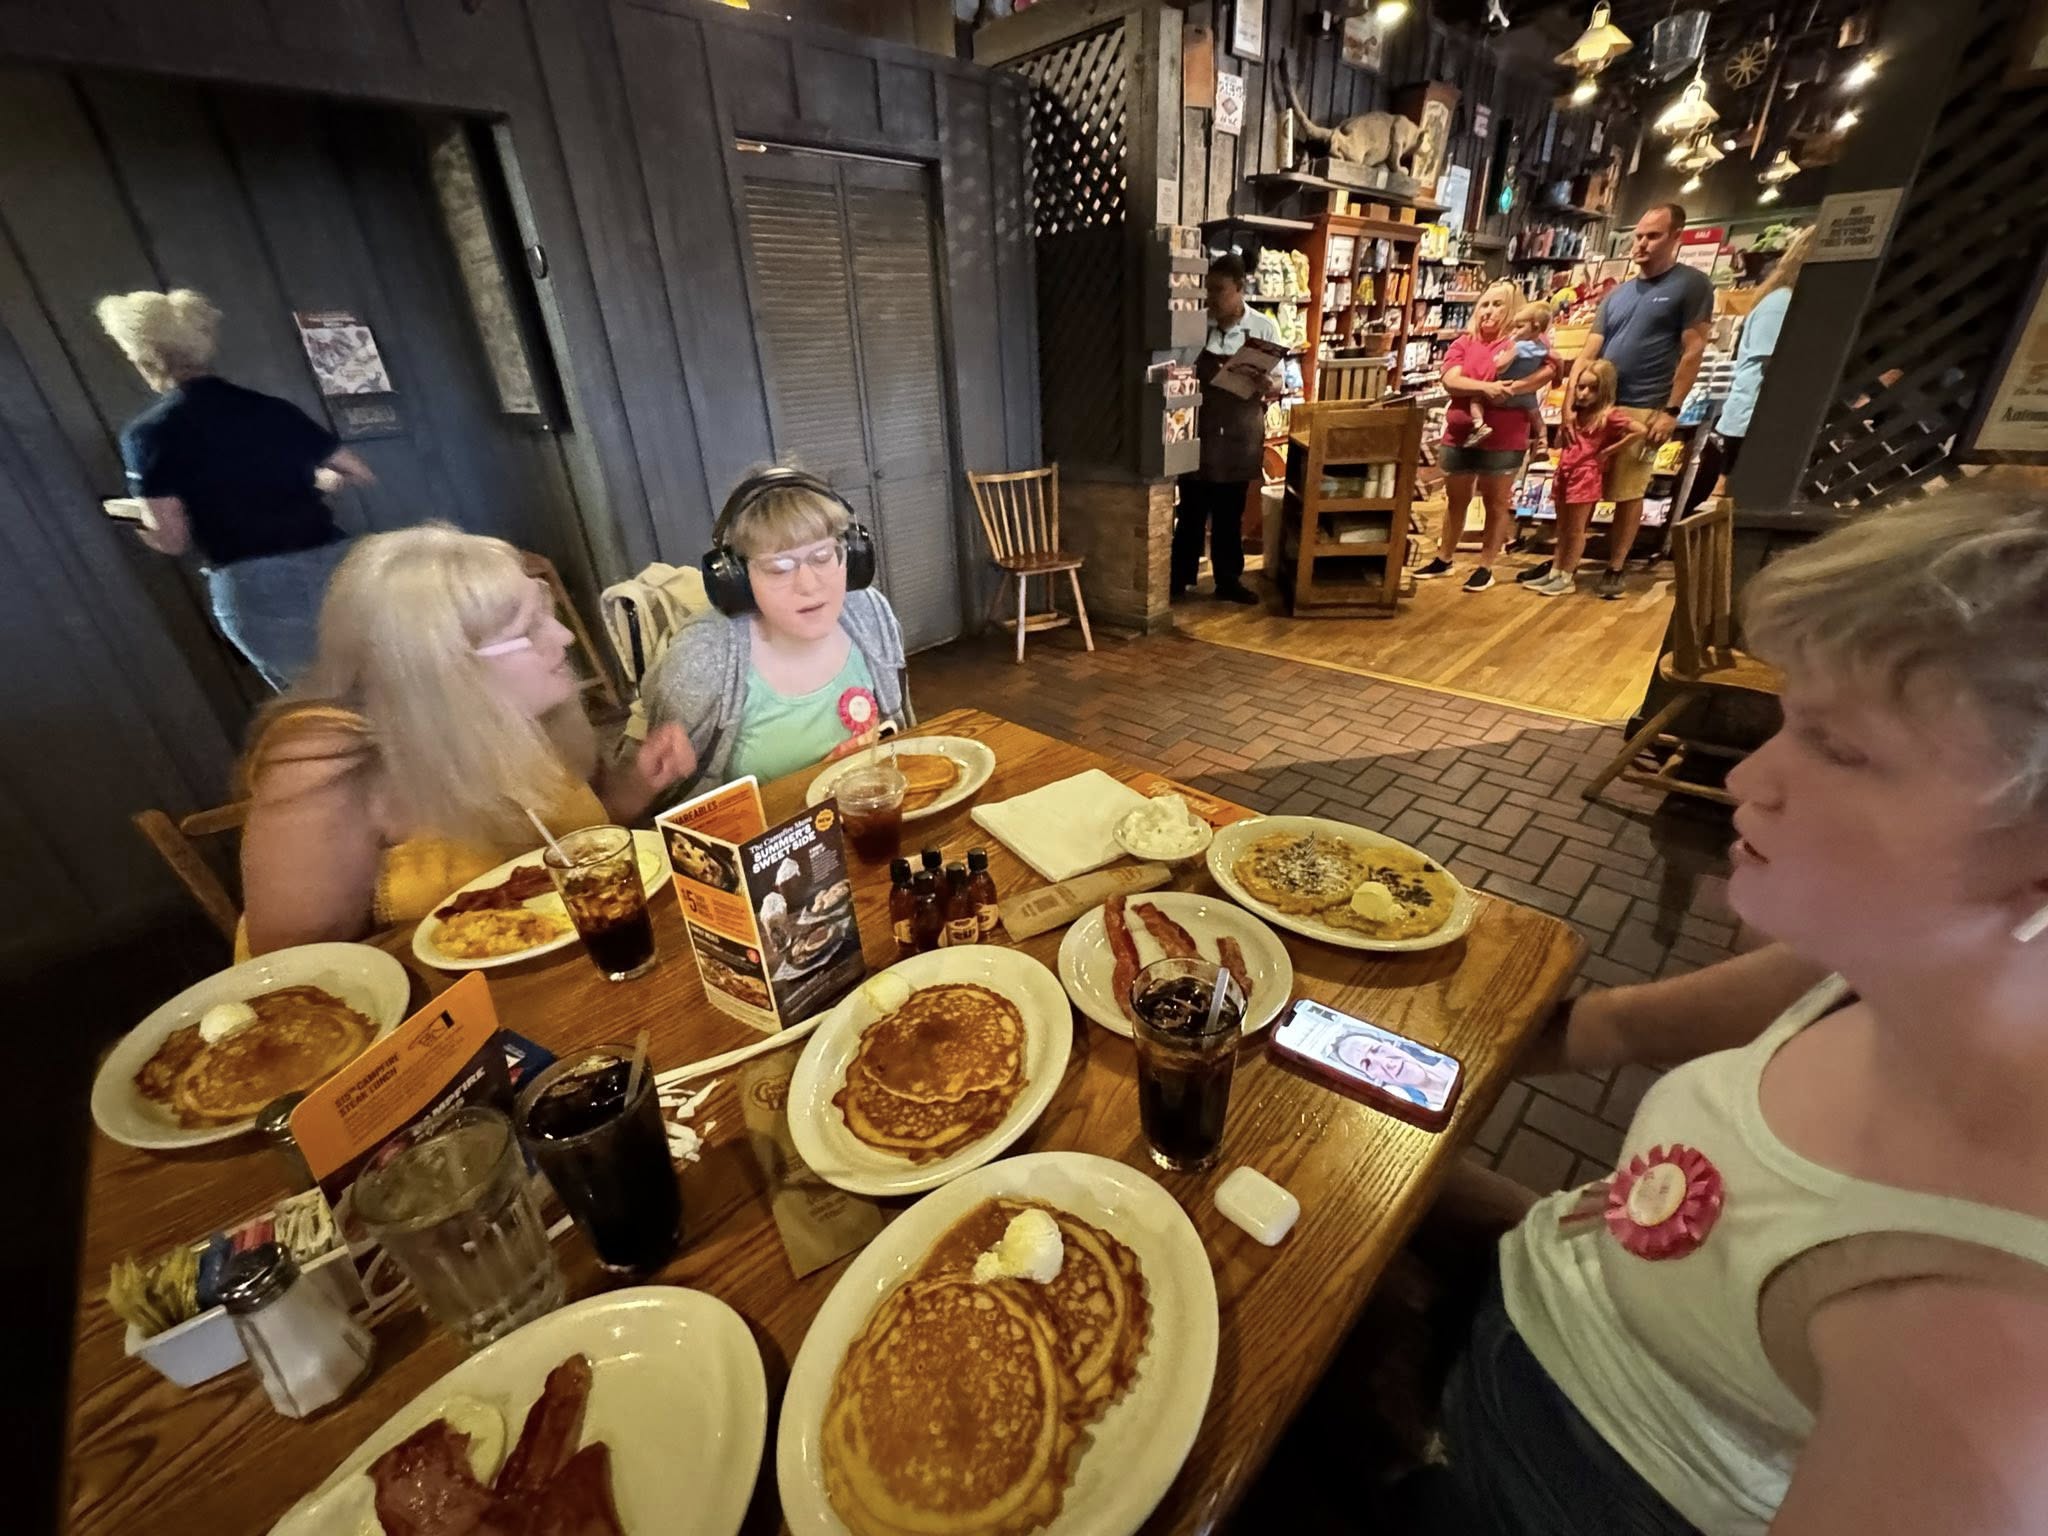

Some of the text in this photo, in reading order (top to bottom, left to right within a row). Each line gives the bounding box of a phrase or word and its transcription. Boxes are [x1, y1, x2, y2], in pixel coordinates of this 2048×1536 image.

[748, 842, 763, 854] The
[763, 826, 794, 847] Campfire
[752, 845, 791, 874] SWEET
[792, 830, 817, 851] SIDE
[753, 823, 812, 863] SUMMER'S
